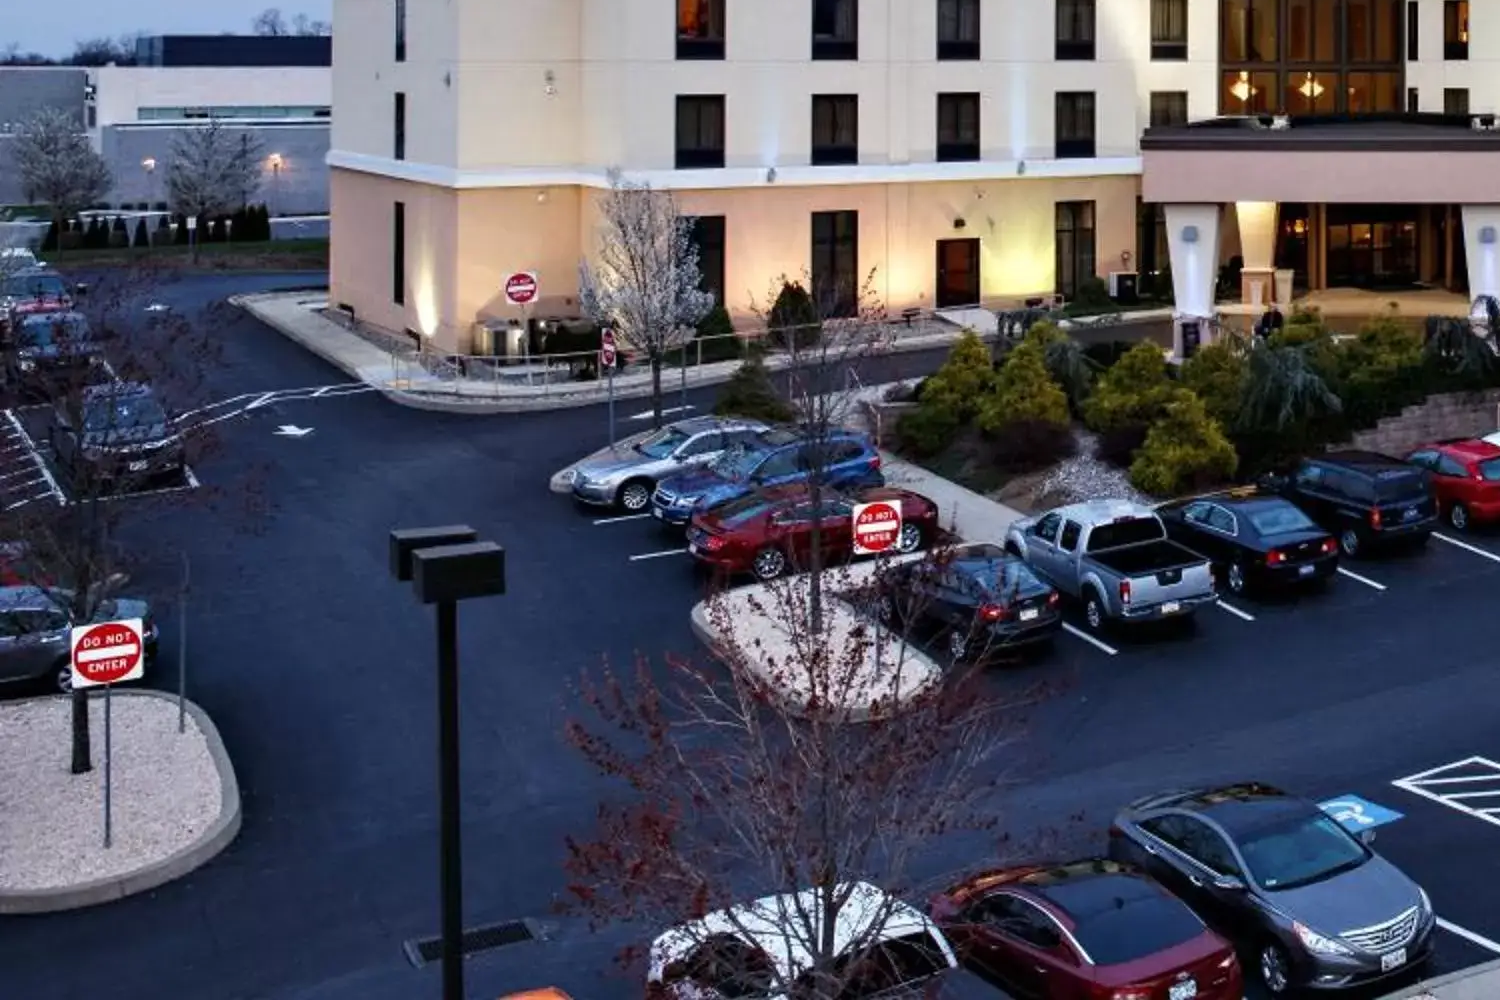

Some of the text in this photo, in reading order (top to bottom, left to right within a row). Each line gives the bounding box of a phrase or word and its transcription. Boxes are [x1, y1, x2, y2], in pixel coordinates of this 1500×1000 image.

[860, 513, 873, 522] DO
[83, 631, 132, 648] DO NOT
[87, 658, 128, 673] ENTER
